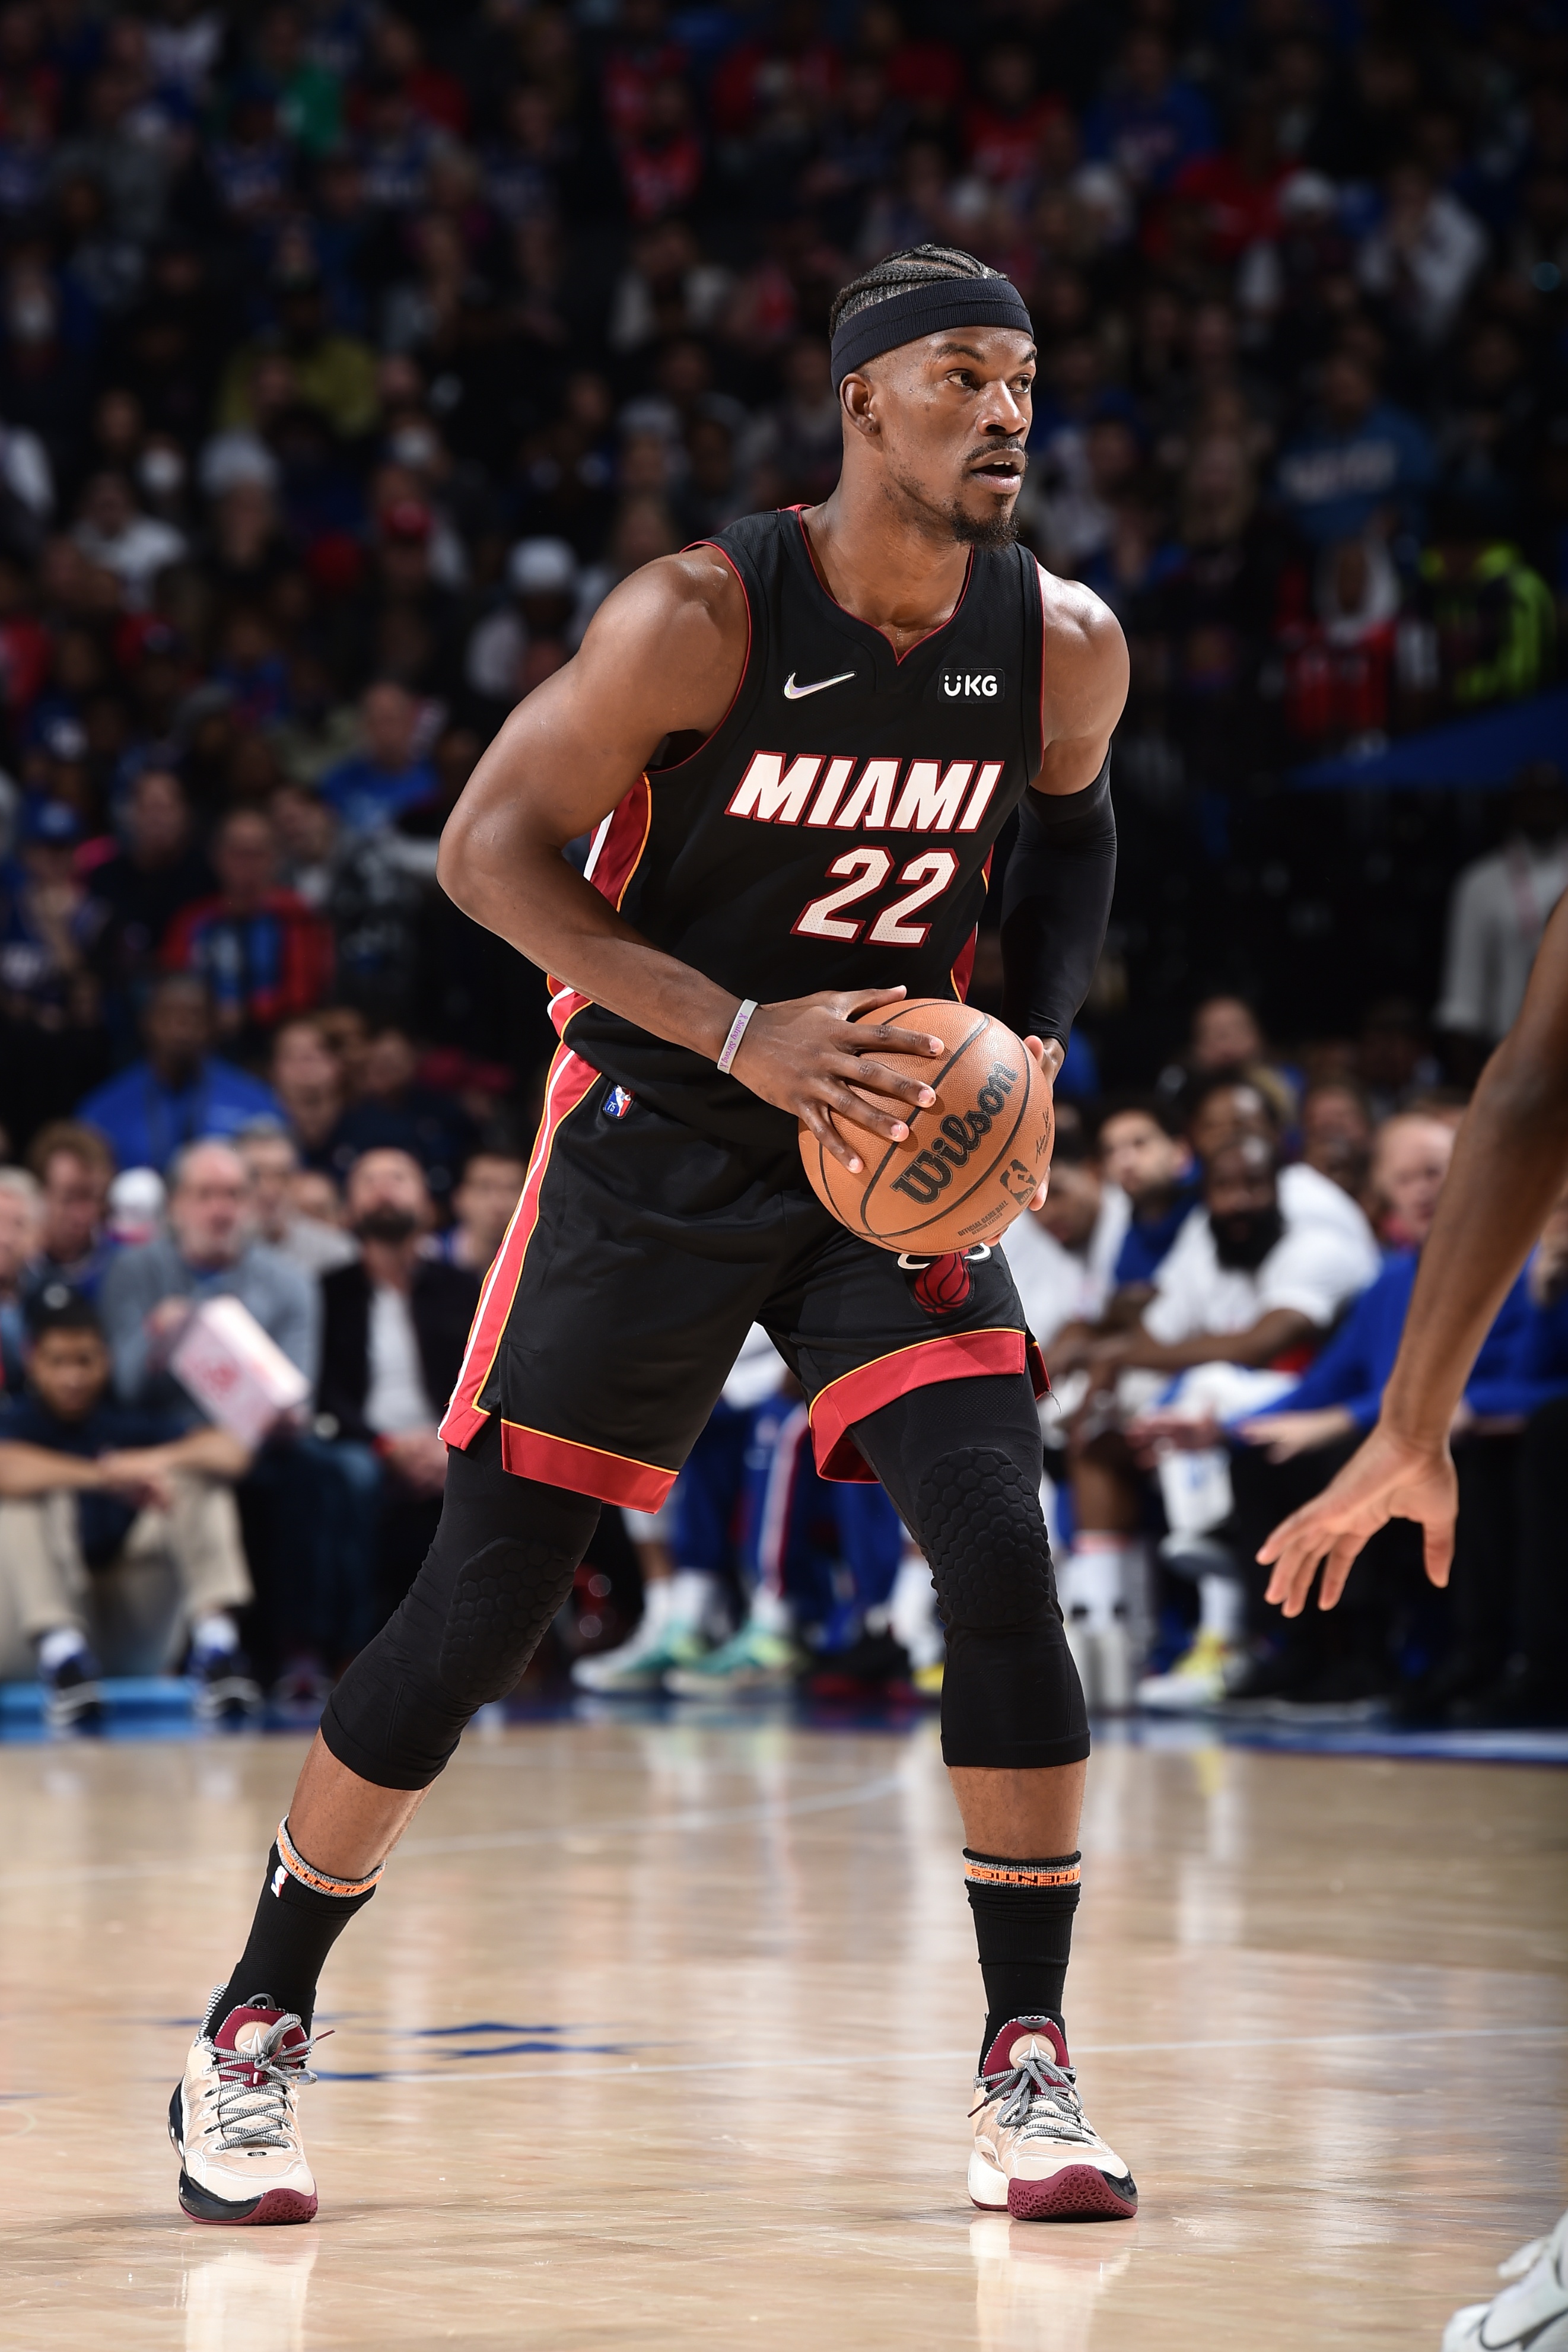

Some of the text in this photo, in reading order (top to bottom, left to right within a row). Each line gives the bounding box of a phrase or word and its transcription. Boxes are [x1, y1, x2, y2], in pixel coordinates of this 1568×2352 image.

[724, 750, 1004, 832] MIAMI
[790, 845, 960, 948] 22
[721, 1041, 736, 1064] Strong
[889, 1061, 1019, 1205] Wilson
[958, 1200, 1009, 1237] OFFICIAL GAME BALL
